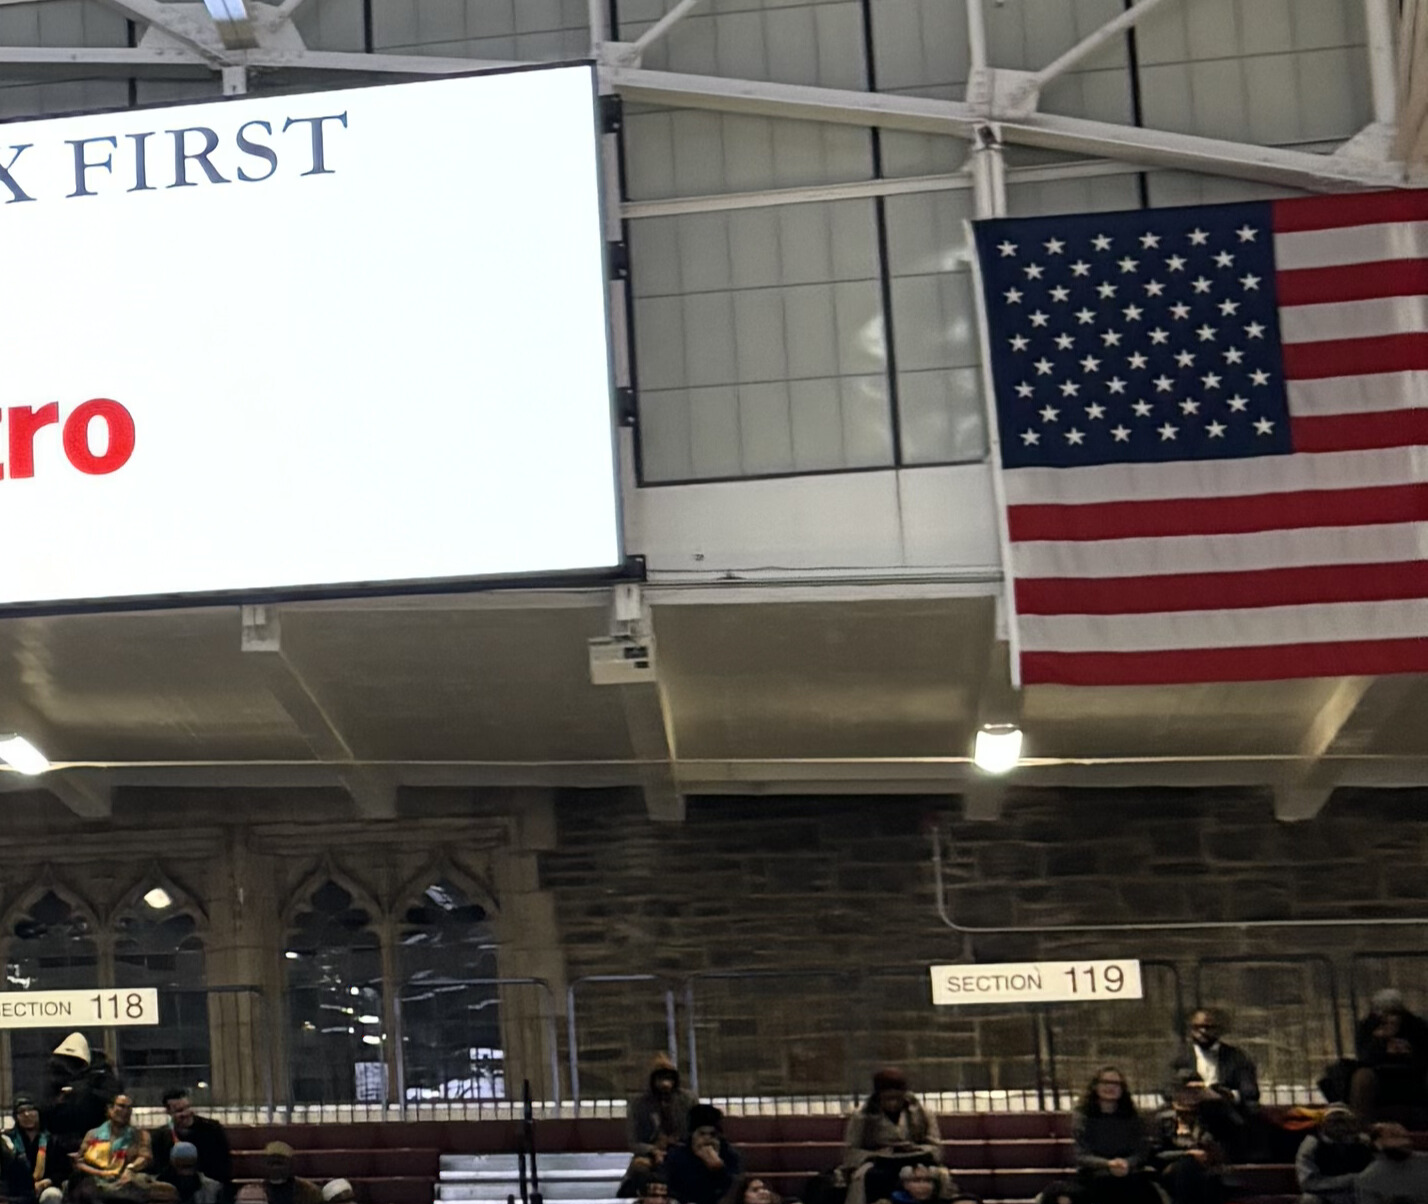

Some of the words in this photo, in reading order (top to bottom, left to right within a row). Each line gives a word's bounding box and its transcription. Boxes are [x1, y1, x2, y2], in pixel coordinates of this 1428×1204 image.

[64, 110, 349, 199] FIRST
[947, 974, 1043, 993] SECTION
[1064, 965, 1125, 994] 119
[90, 993, 144, 1020] 118
